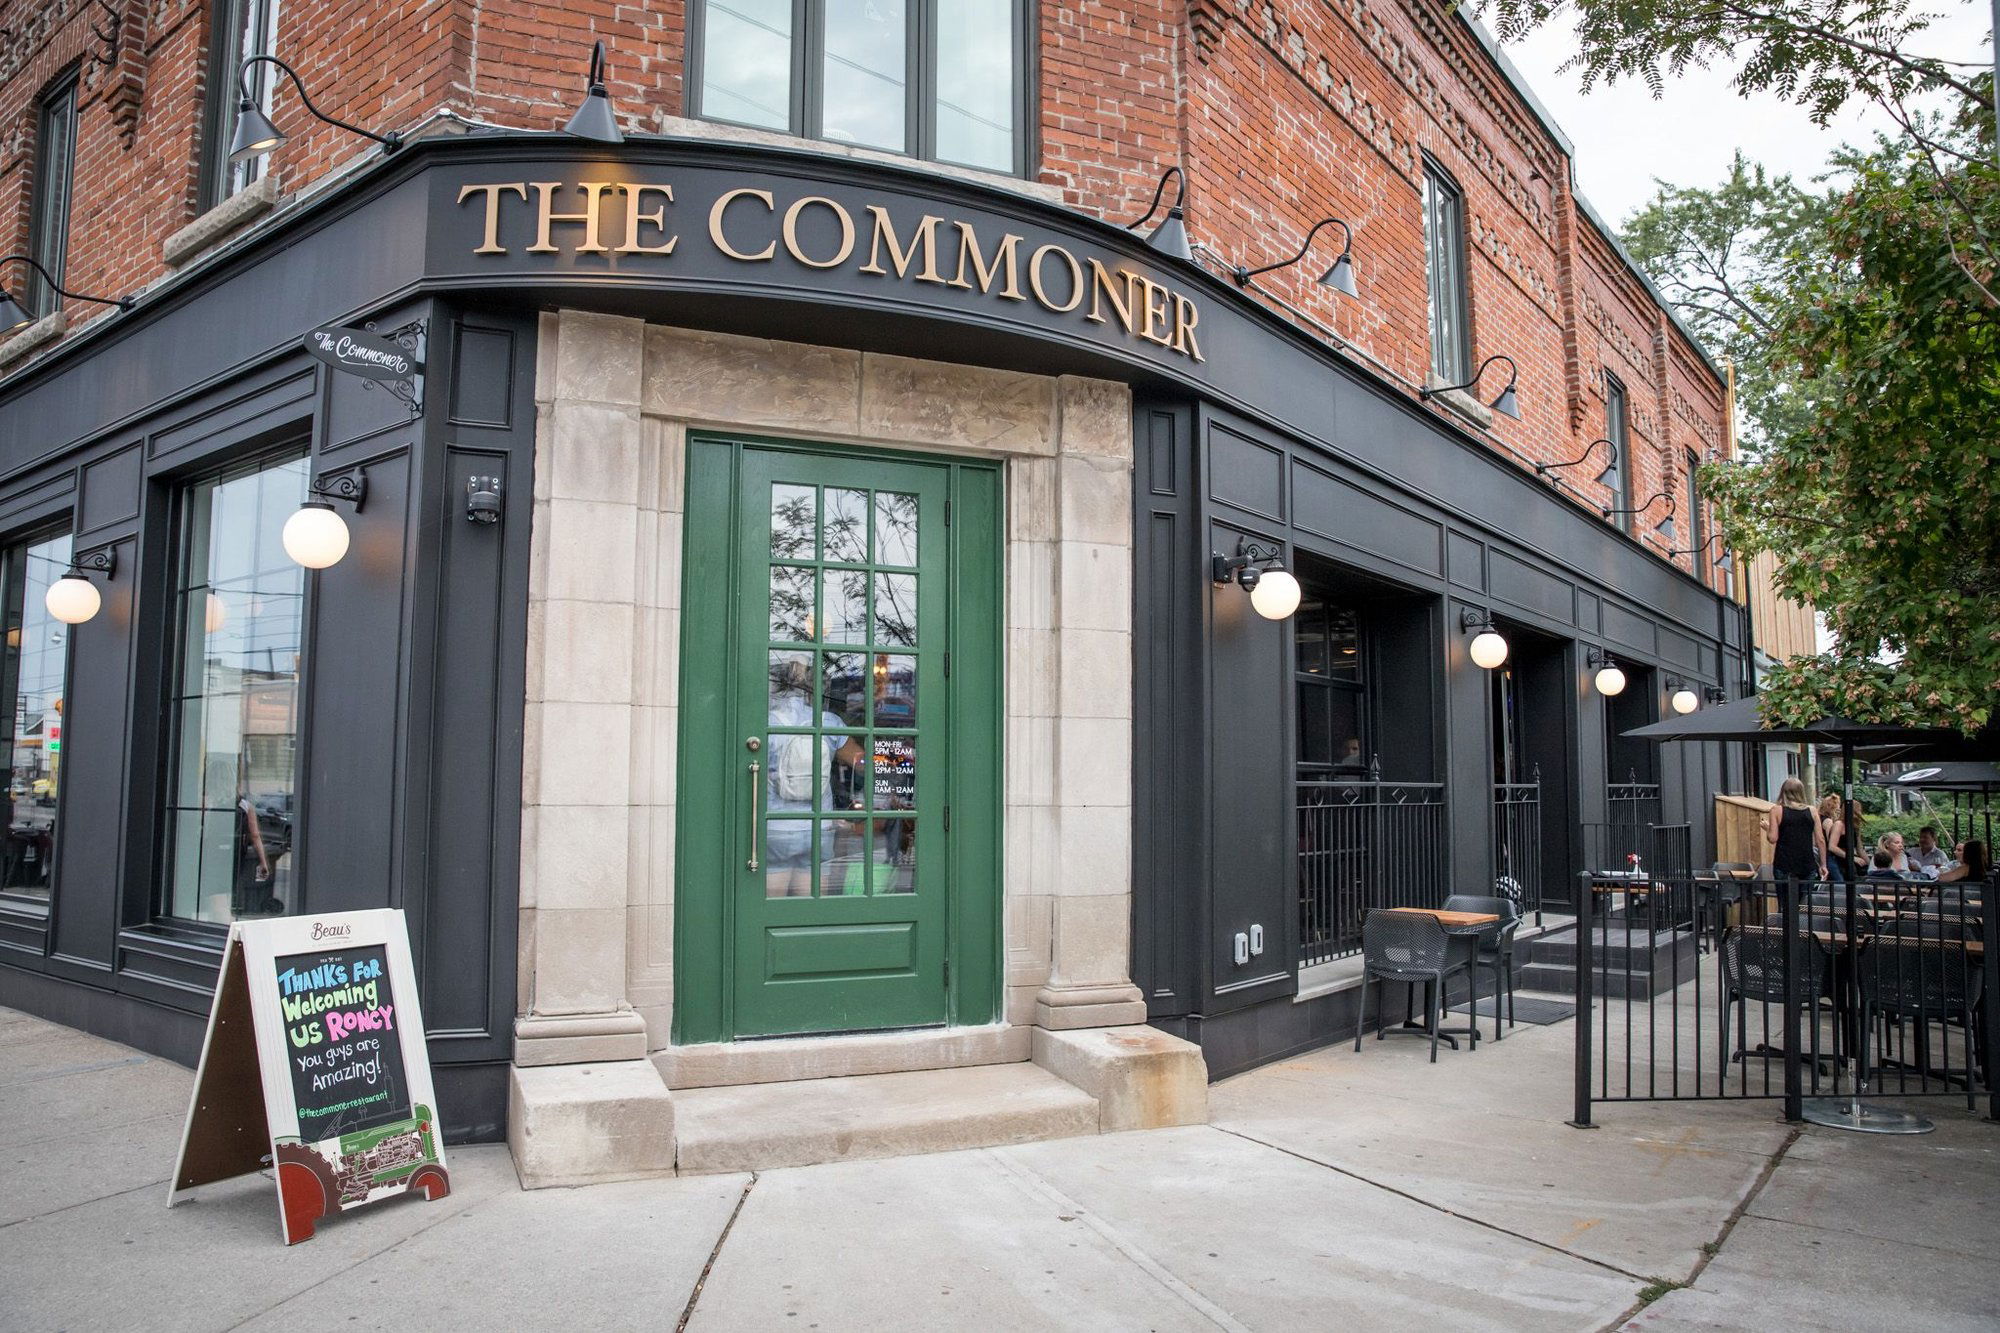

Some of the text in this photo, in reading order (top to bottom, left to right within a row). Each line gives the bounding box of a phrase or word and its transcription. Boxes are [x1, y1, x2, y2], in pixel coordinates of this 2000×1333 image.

[457, 181, 1206, 363] THE COMMONER
[314, 331, 408, 373] The Commoner
[874, 740, 902, 748] MON-FRI
[875, 747, 889, 755] 5PM
[894, 747, 912, 755] 12AM
[311, 922, 351, 940] Beau's
[278, 963, 348, 996] THANKS
[282, 980, 378, 1022] Welcoming
[326, 1044, 353, 1067] guys
[356, 1038, 380, 1051] are
[313, 1051, 382, 1092] Amazing!
[299, 1090, 389, 1118] @thecommonerrestaurant
